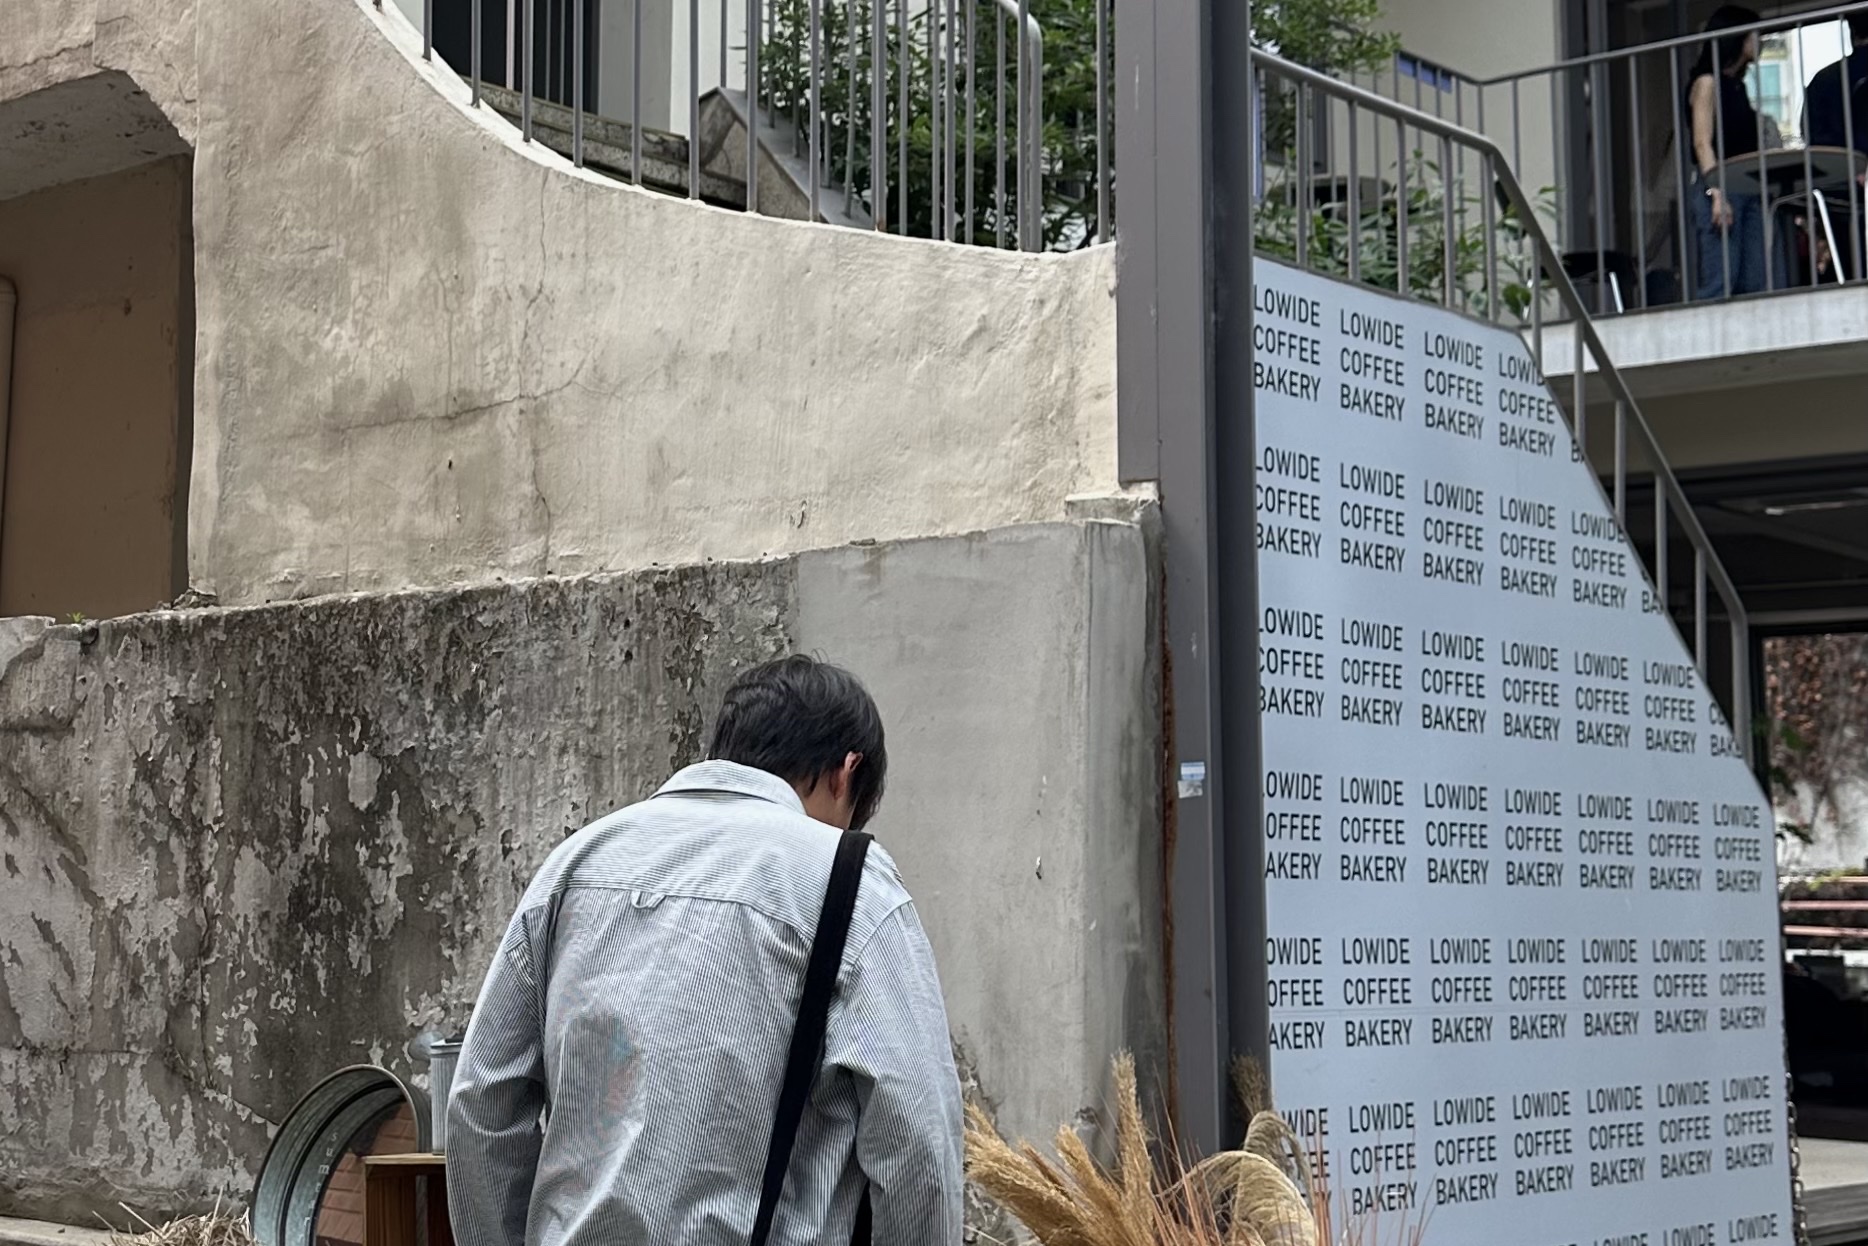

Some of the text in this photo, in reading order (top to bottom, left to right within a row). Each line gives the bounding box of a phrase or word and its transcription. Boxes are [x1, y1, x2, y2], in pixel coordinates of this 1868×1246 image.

[1254, 284, 1483, 370] LOWIDE LOWIDE LOWIDE
[1253, 324, 1557, 425] COFFEE COFFEE COFFEE COFFEE
[1253, 361, 1322, 402] BAKERY
[1340, 383, 1405, 421] BAKERY
[1425, 403, 1484, 439] BAKERY
[1499, 422, 1555, 456] BAKERY
[1340, 463, 1556, 530] LOWIDE LOWIDE LOWIDE
[1340, 501, 1626, 578] COFFEE COFFEE COFFEE COFFEE
[1341, 537, 1405, 572] BAKERY
[1423, 552, 1484, 586] BAKERY
[1501, 566, 1557, 597] BAKERY
[1573, 579, 1627, 608] BAKERY
[1342, 618, 1694, 689] LOWIDE LOWIDE LOWIDE LOWIDE LOWIDE
[1341, 657, 1402, 690] COFFEE
[1421, 667, 1486, 699] COFFEE
[1502, 677, 1559, 708] COFFEE
[1575, 686, 1630, 715] COFFEE
[1644, 695, 1695, 723] COFFEE
[1341, 694, 1403, 726] BAKERY
[1422, 704, 1486, 733] BAKERY
[1504, 712, 1560, 741] BAKERY
[1577, 720, 1630, 747] BAKERY
[1646, 727, 1696, 753] BAKERY
[1267, 771, 1760, 829] OWIDE LOWIDE LOWIDE LOWIDE LOWIDE LOWIDE LOWIDE
[1266, 812, 1761, 862] OFFEE COFFEE COFFEE COFFEE COFFEE COFFEE COFFEE
[1265, 851, 1762, 893] AKERY BAKERY BAKERY BAKERY BAKERY BAKERY BAKERY
[1342, 938, 1765, 965] LOWIDE LOWIDE LOWIDE LOWIDE LOWIDE LOWIDE
[1268, 973, 1765, 1007] OFFEE COFFEE COFFEE COFFEE COFFEE COFFEE COFFEE
[1270, 1021, 1325, 1049] AKERY
[1345, 1019, 1412, 1047] BAKERY
[1432, 1016, 1493, 1044] BAKERY
[1510, 1014, 1567, 1040] BAKERY
[1584, 1011, 1639, 1037] BAKERY
[1655, 1009, 1707, 1034] BAKERY
[1349, 1076, 1770, 1134] LOWIDE LOWIDE LOWIDE LOWIDE LOWIDE LOWIDE
[1350, 1142, 1416, 1176] COFFEE
[1435, 1135, 1497, 1167] COFFEE
[1514, 1128, 1572, 1159] COFFEE
[1589, 1122, 1644, 1151] COFFEE
[1659, 1116, 1711, 1144] COFFEE
[1724, 1109, 1772, 1137] COFFEE
[1353, 1181, 1418, 1216] BAKERY
[1436, 1172, 1498, 1205] BAKERY
[1516, 1164, 1574, 1196] BAKERY
[1590, 1157, 1645, 1187] BAKERY
[1661, 1150, 1712, 1179] BAKERY
[1725, 1143, 1773, 1170] BAKERY
[1729, 1213, 1778, 1243] LOWIDE
